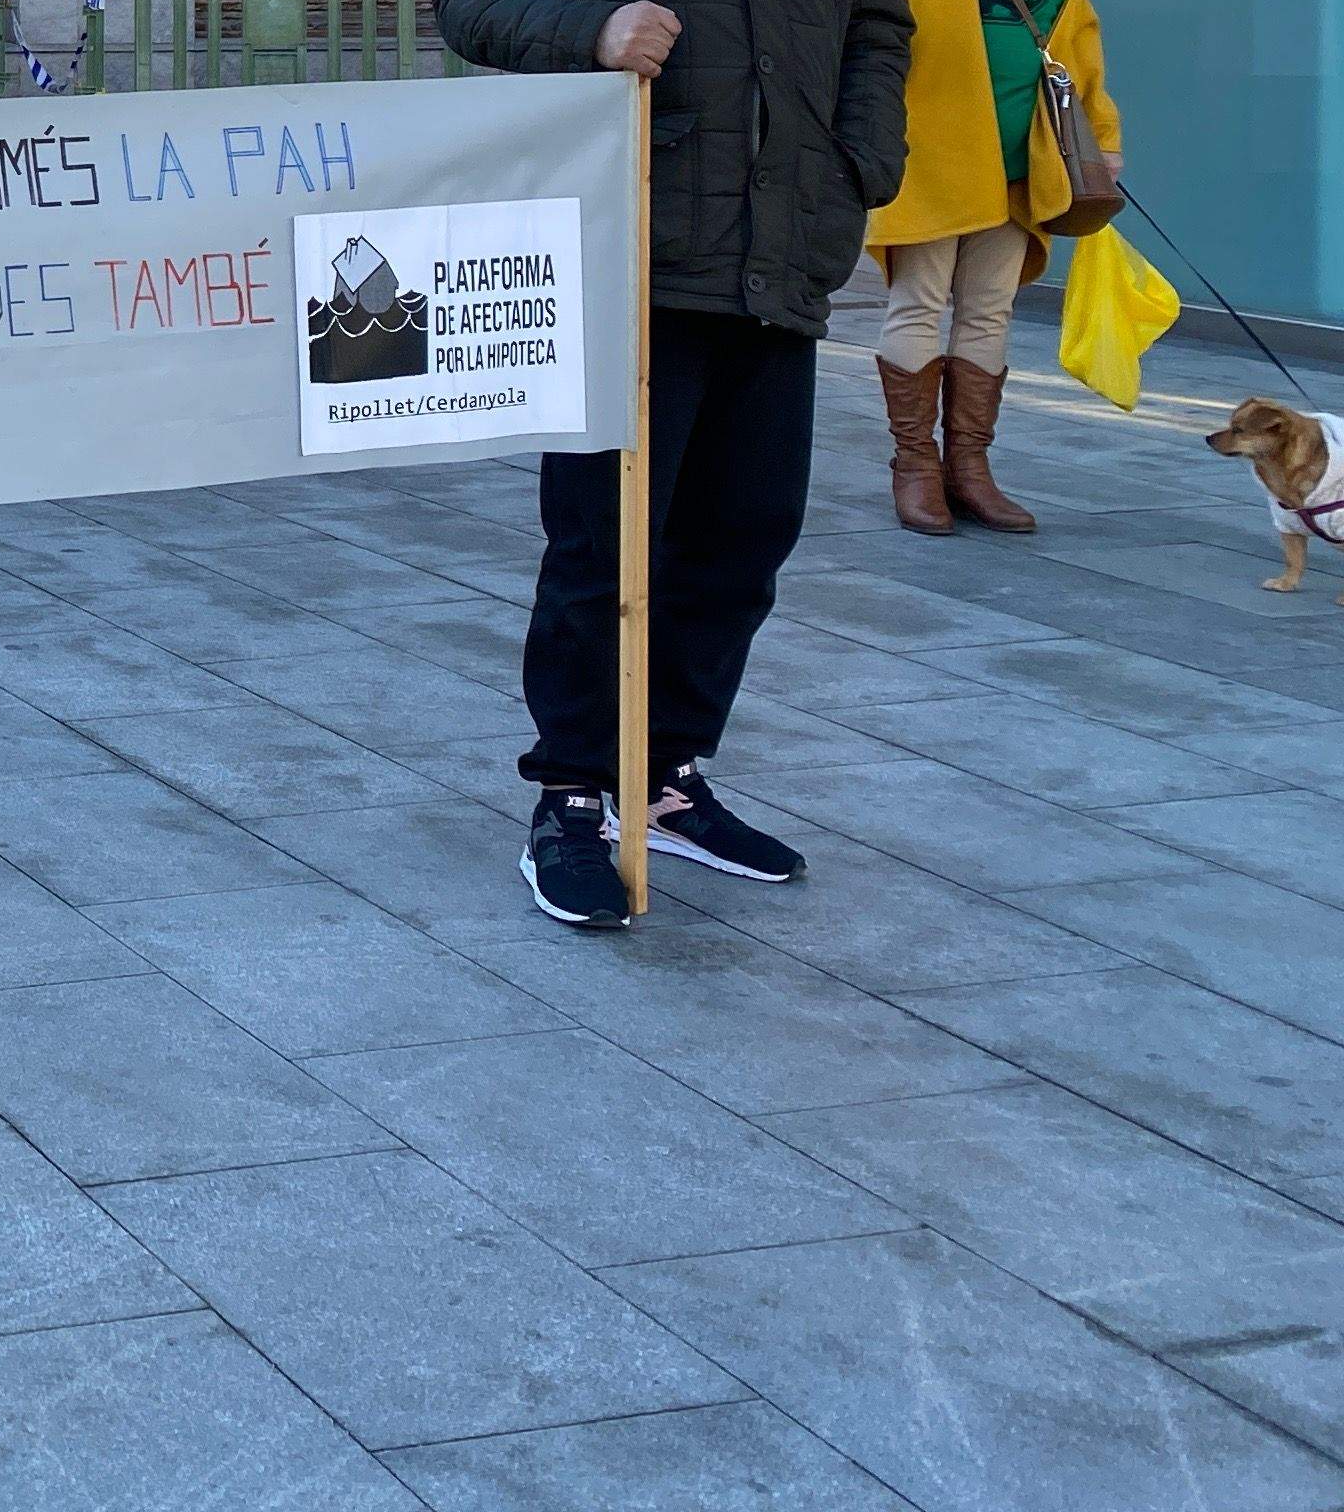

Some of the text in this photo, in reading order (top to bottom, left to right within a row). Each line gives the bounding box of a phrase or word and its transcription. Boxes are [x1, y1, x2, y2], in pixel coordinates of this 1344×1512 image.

[122, 132, 195, 201] LA
[223, 122, 355, 196] PAH
[94, 238, 275, 331] TAMBÉ
[434, 254, 555, 294] PLATAFORMA
[435, 297, 557, 336] DE AFECTADOS
[436, 339, 557, 374] POR LA HIPOTECA
[329, 387, 527, 422] Ripollet/Cerdanyola
